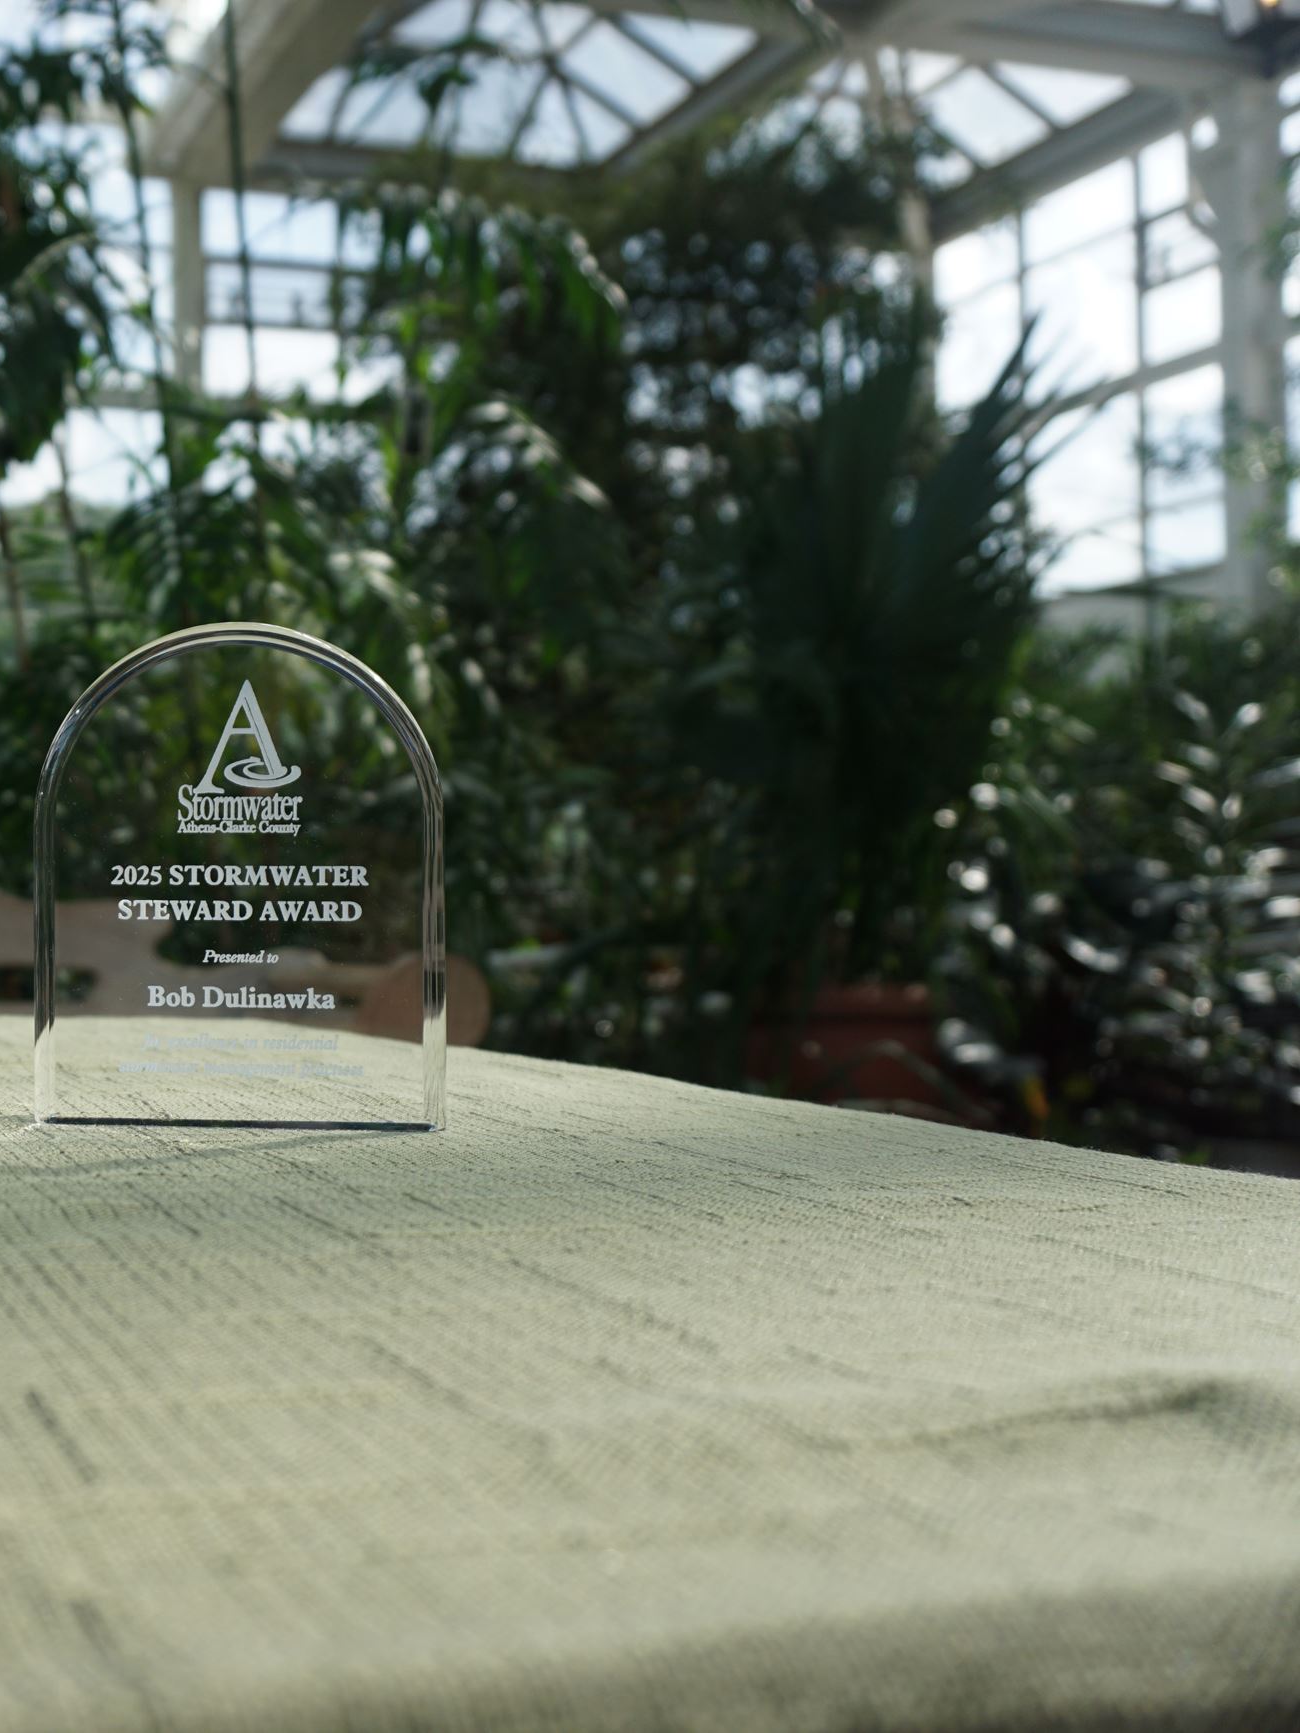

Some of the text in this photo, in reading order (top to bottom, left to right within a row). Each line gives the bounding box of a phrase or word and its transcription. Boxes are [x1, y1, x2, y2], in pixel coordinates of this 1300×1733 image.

[177, 784, 303, 821] Stormwater
[177, 819, 302, 837] Athens-Clarke County
[110, 864, 370, 887] 2025 STORMWATER
[117, 899, 363, 922] STEWARD AWARD
[202, 949, 280, 964] Presented to
[147, 985, 336, 1010] Bob Dulinawka
[262, 1034, 340, 1051] residential
